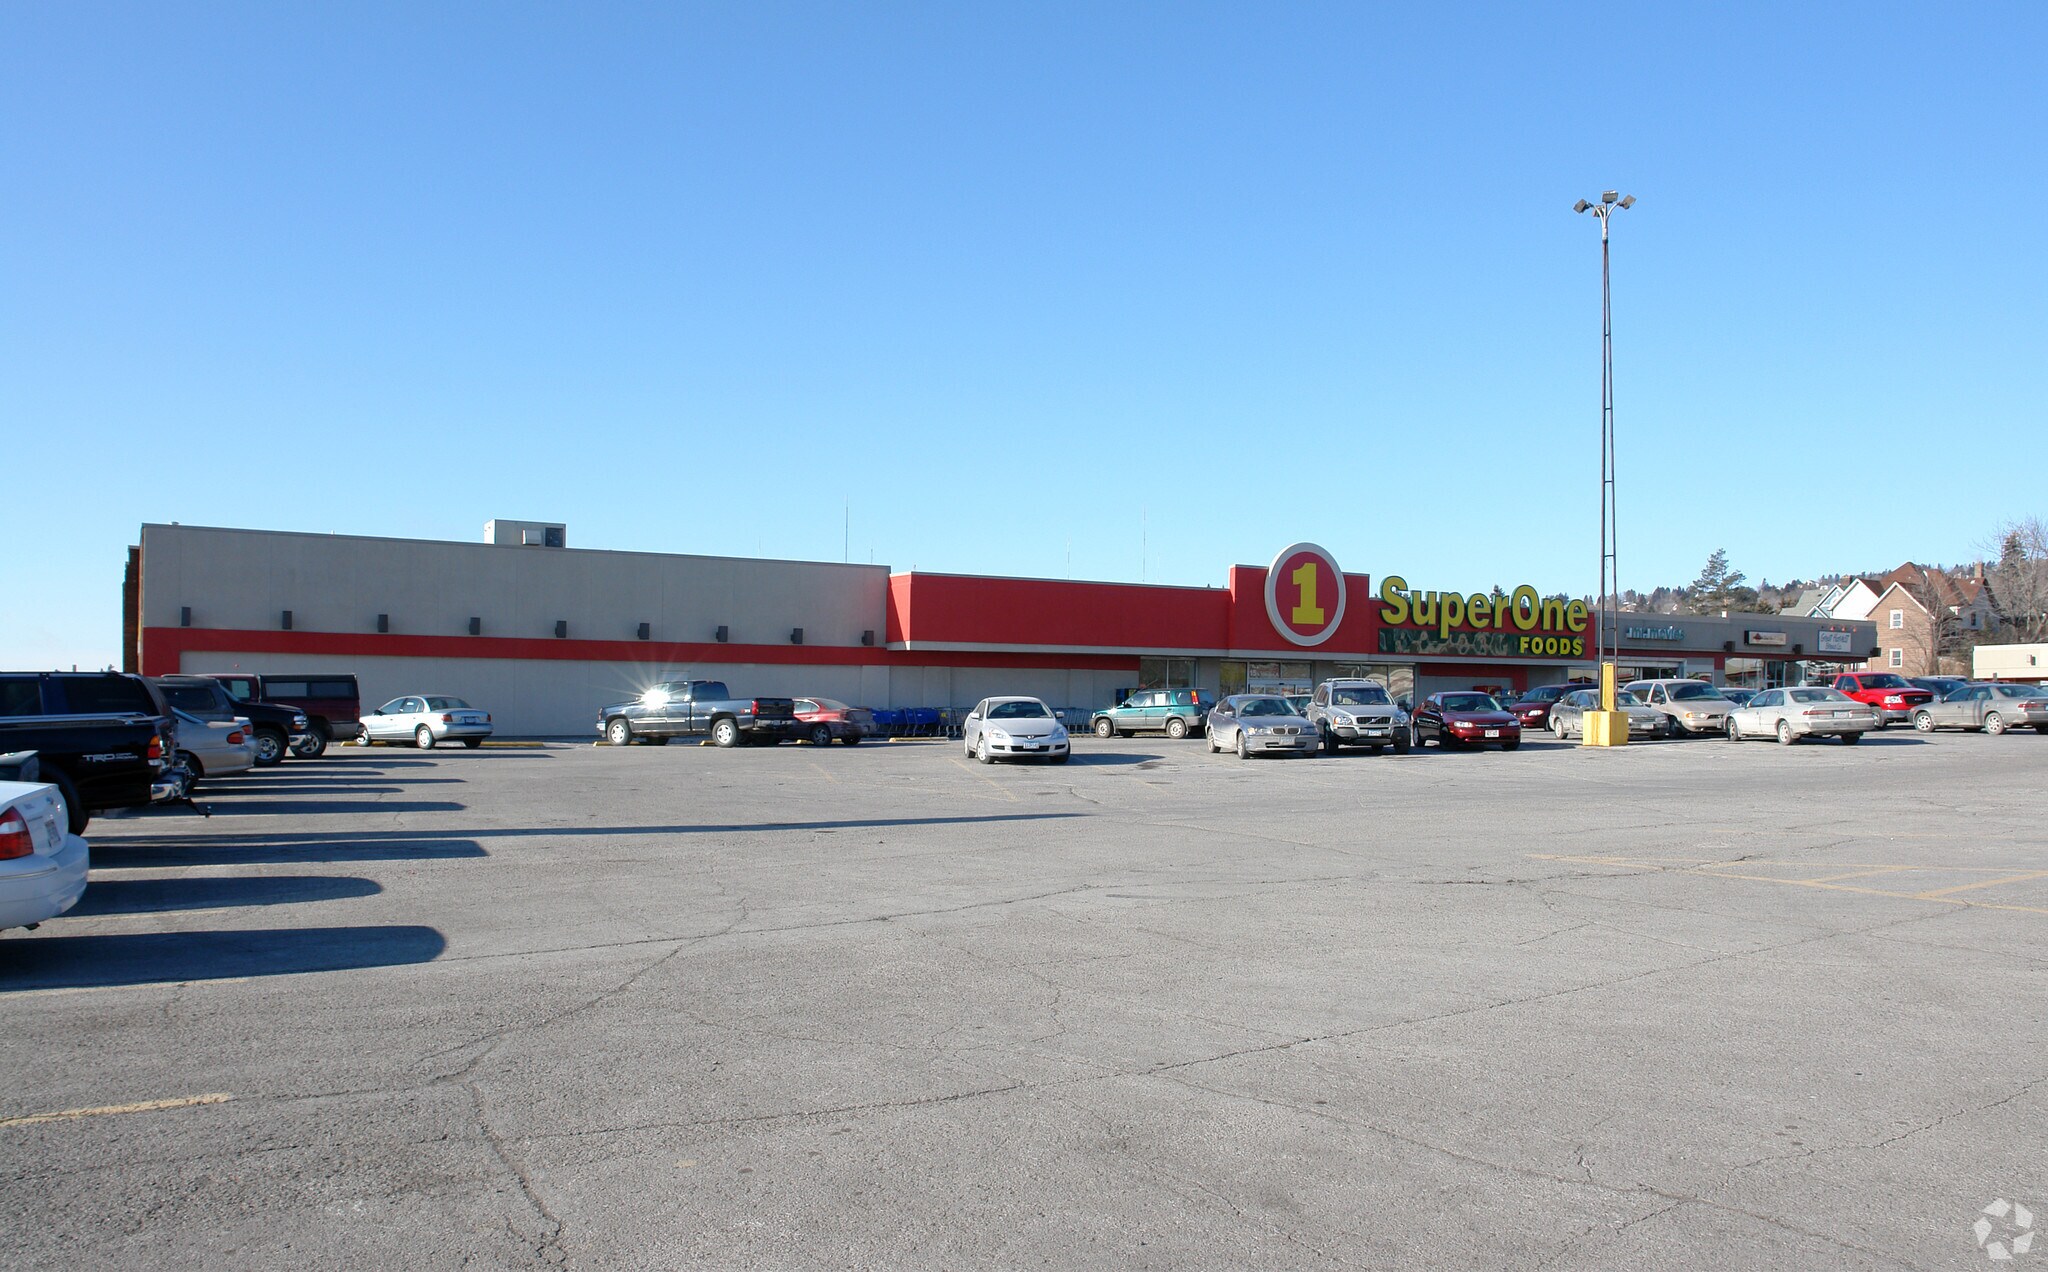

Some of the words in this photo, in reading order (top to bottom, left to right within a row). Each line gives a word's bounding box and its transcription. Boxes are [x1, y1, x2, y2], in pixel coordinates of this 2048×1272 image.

[1292, 563, 1325, 625] 1
[1380, 575, 1588, 639] SuperOne
[1519, 636, 1583, 656] FOODS
